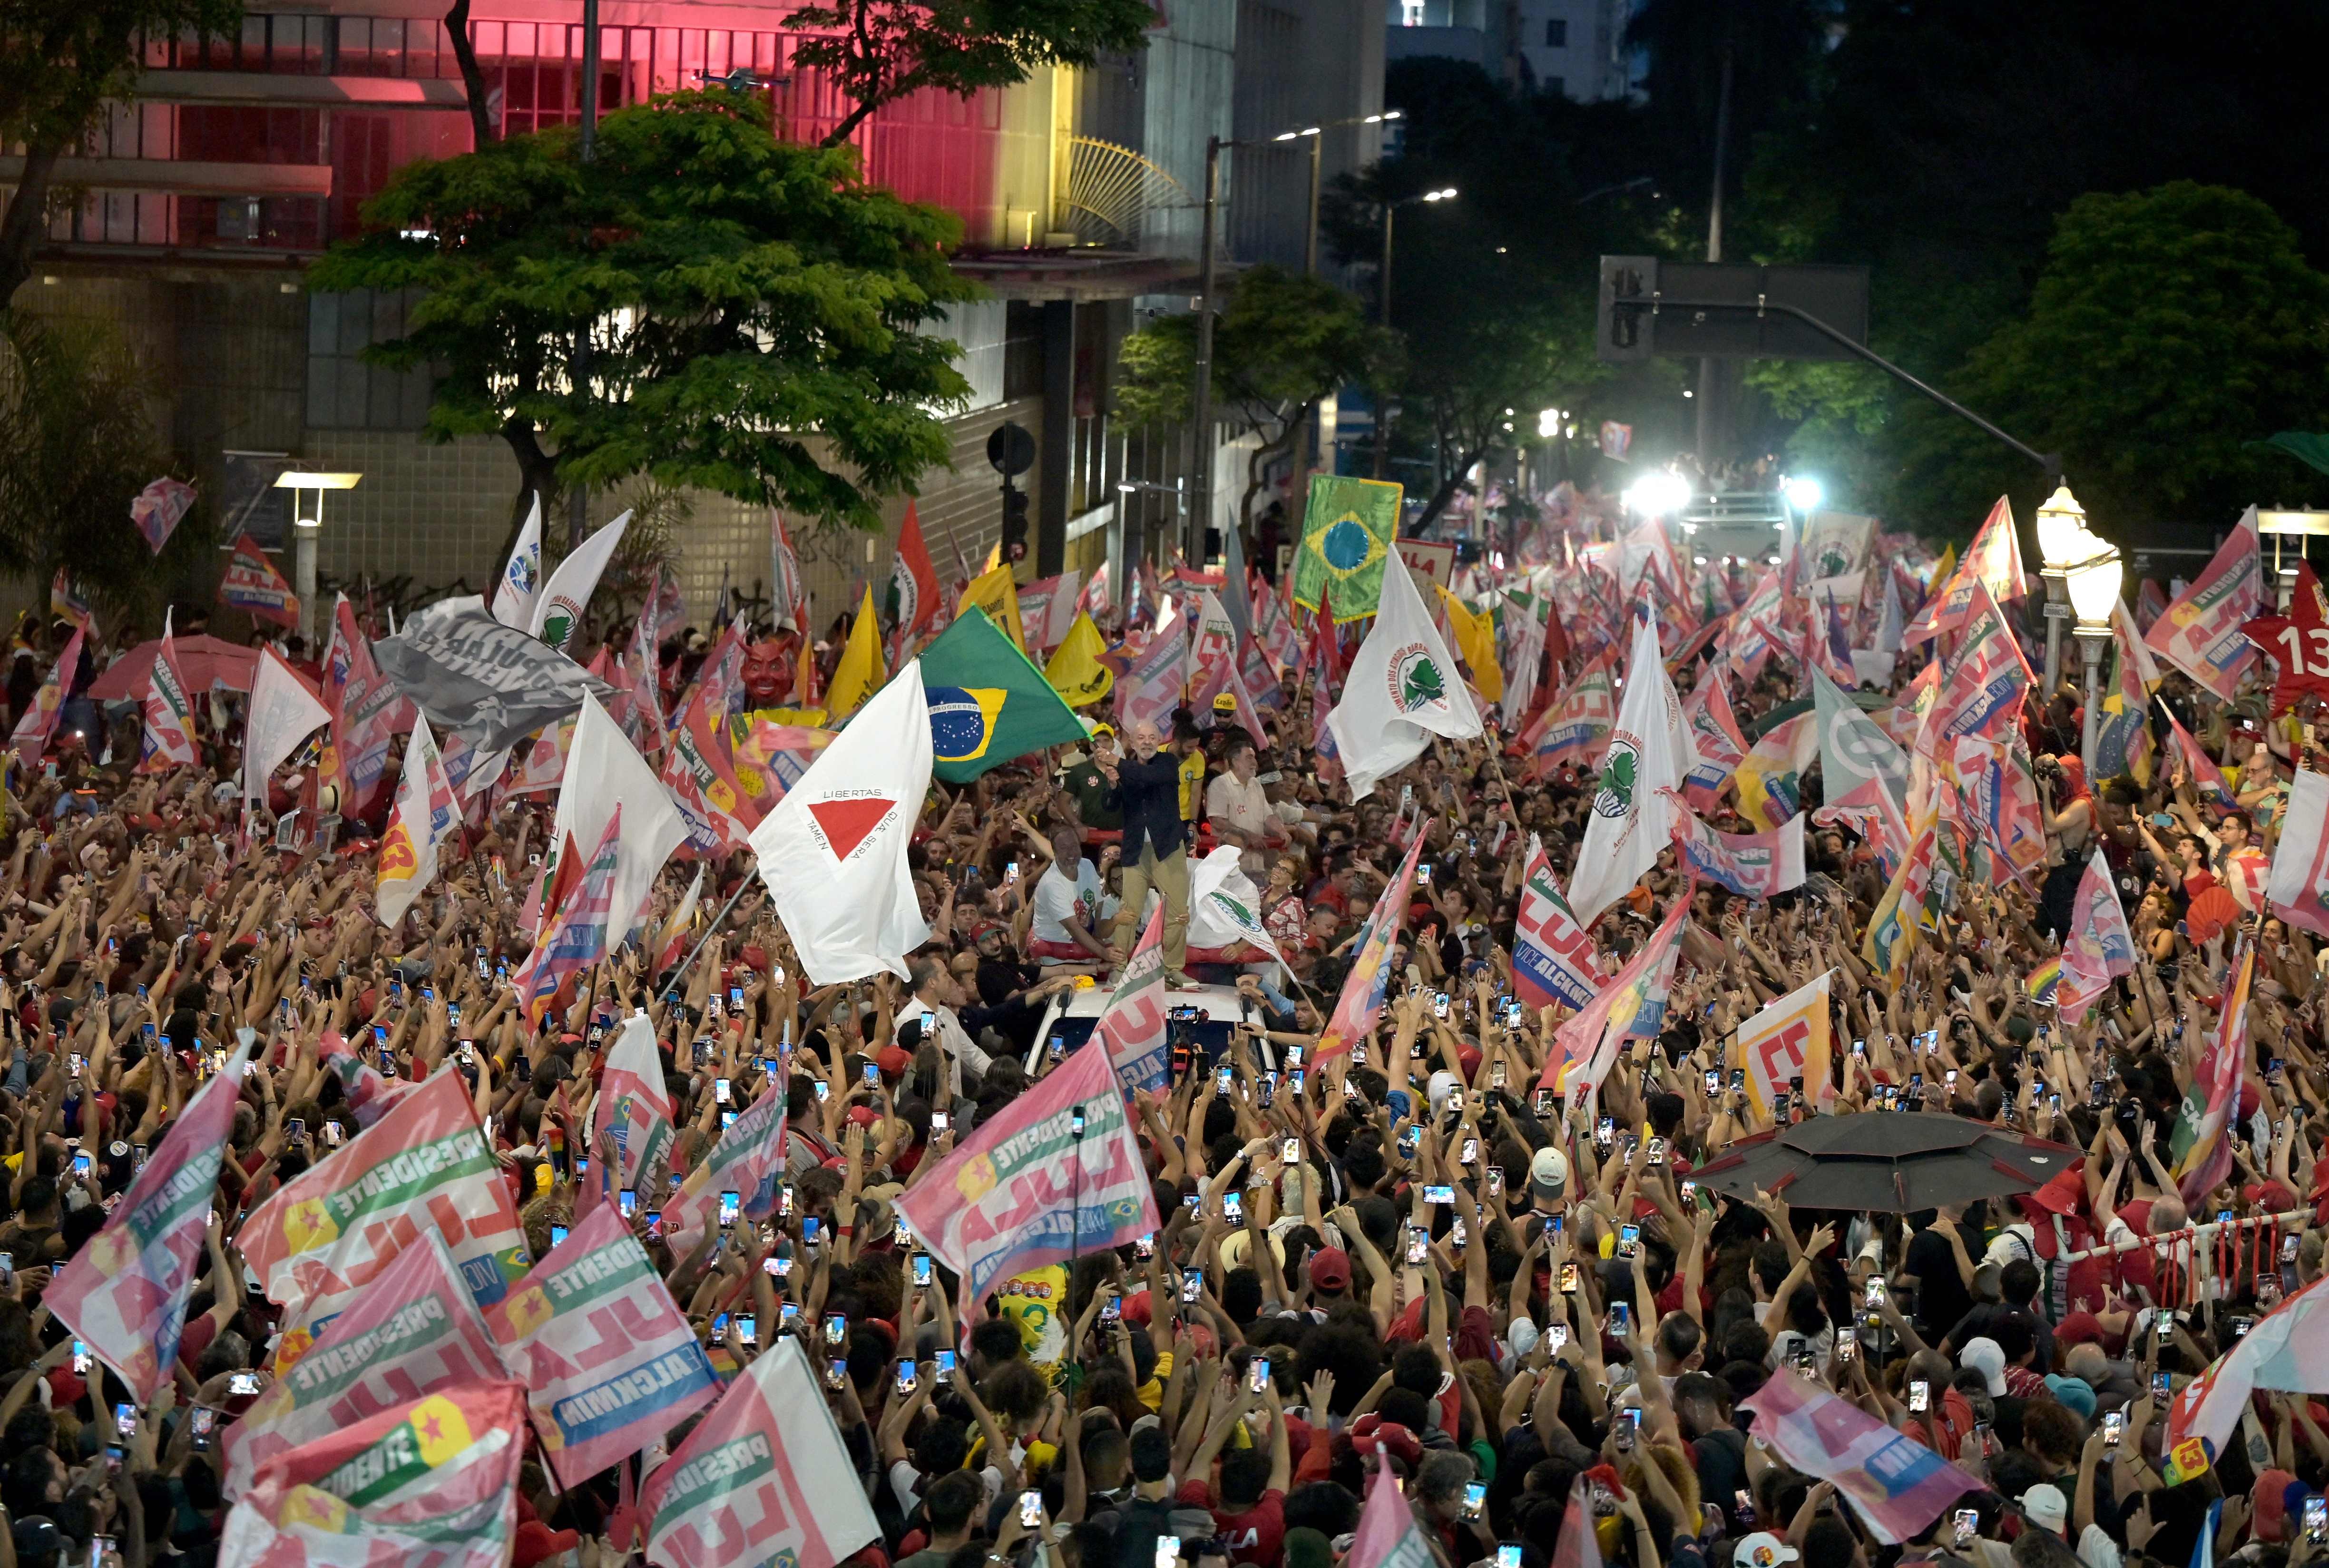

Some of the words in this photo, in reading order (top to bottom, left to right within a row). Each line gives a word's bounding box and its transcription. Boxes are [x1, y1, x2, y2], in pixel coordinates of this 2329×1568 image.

[2277, 626, 2329, 678] 13
[933, 702, 979, 713] PROGRESSO
[1216, 699, 1233, 707] Capão
[823, 789, 882, 799] LIBERTAS
[379, 829, 415, 869] 13
[807, 820, 828, 851] TAMEN
[851, 835, 878, 860] SERA
[1517, 942, 1538, 969] VICE
[2178, 1438, 2206, 1471] 13
